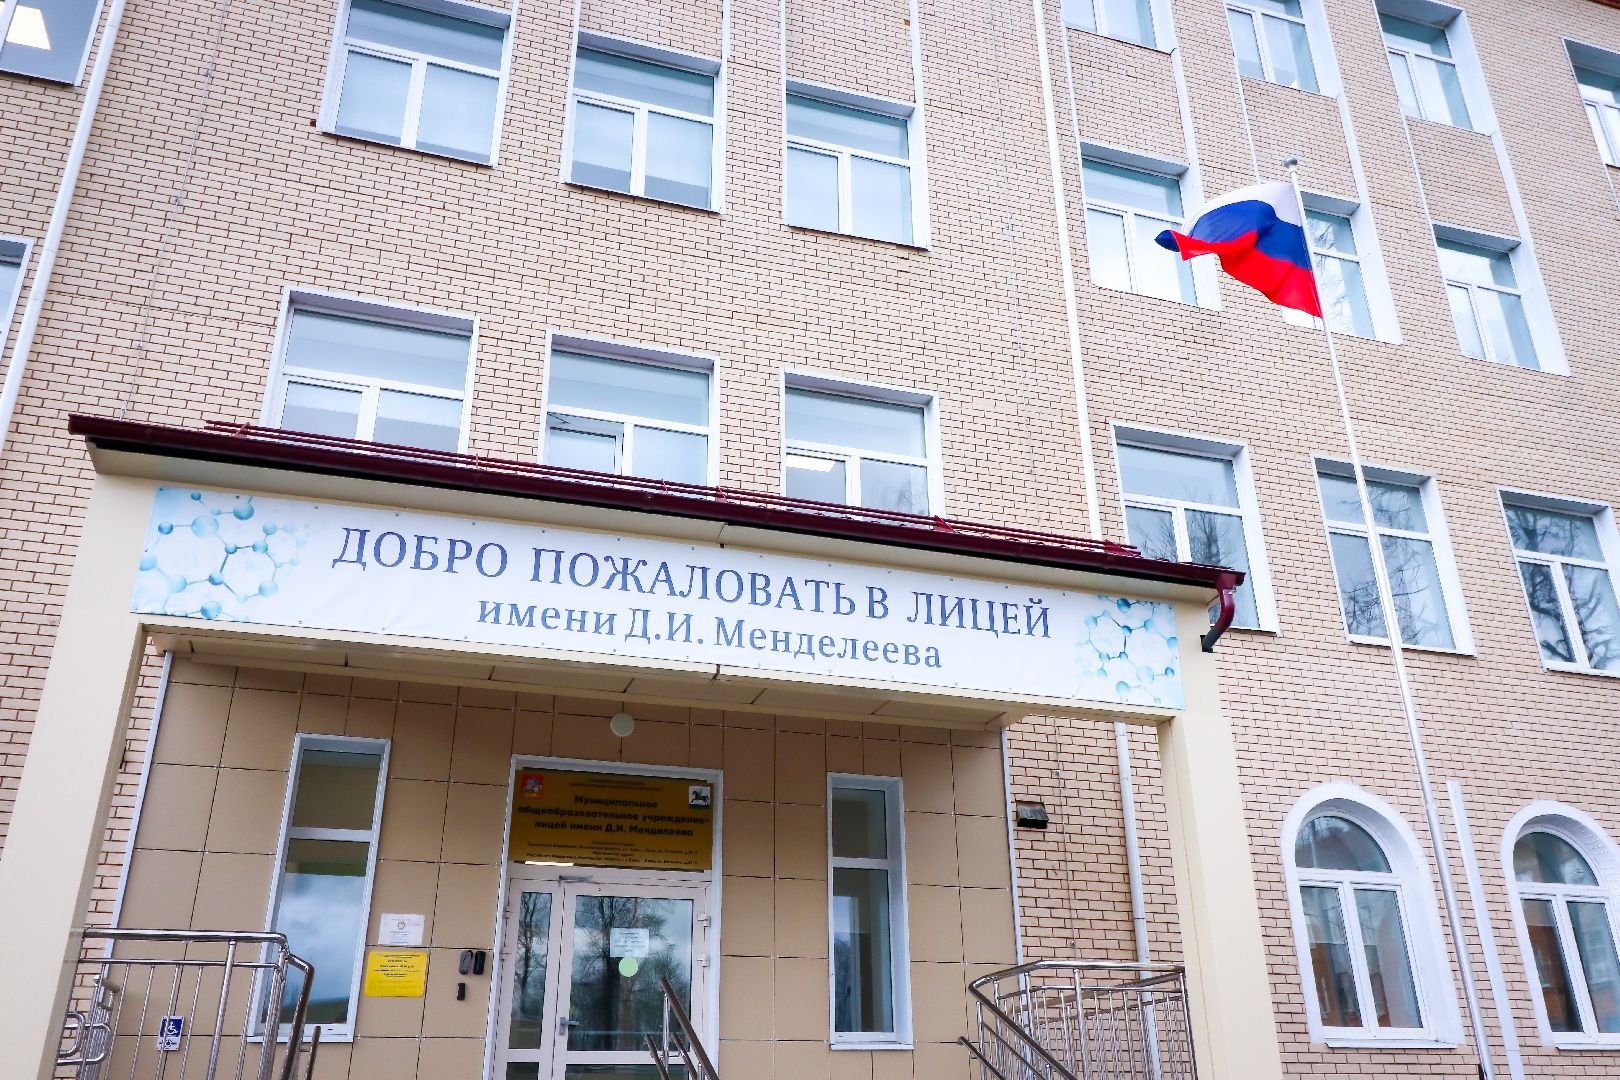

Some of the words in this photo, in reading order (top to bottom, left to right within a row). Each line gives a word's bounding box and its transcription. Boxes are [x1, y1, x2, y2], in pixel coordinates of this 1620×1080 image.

[332, 528, 506, 578] ДОБРО
[529, 548, 855, 615] ПОЖАЛОВАТЬ
[866, 586, 889, 619] В
[907, 592, 1051, 639] ЛИЦЕЙ
[477, 601, 618, 636] имени
[624, 608, 704, 645] Д.И.
[714, 617, 942, 668] Менделеева
[574, 795, 658, 808] Муниципальное
[517, 806, 639, 821] общеобразовательное
[534, 820, 568, 831] лицей
[569, 823, 603, 833] имени
[604, 823, 627, 834] Д.И.
[629, 825, 693, 837] Менделеева
